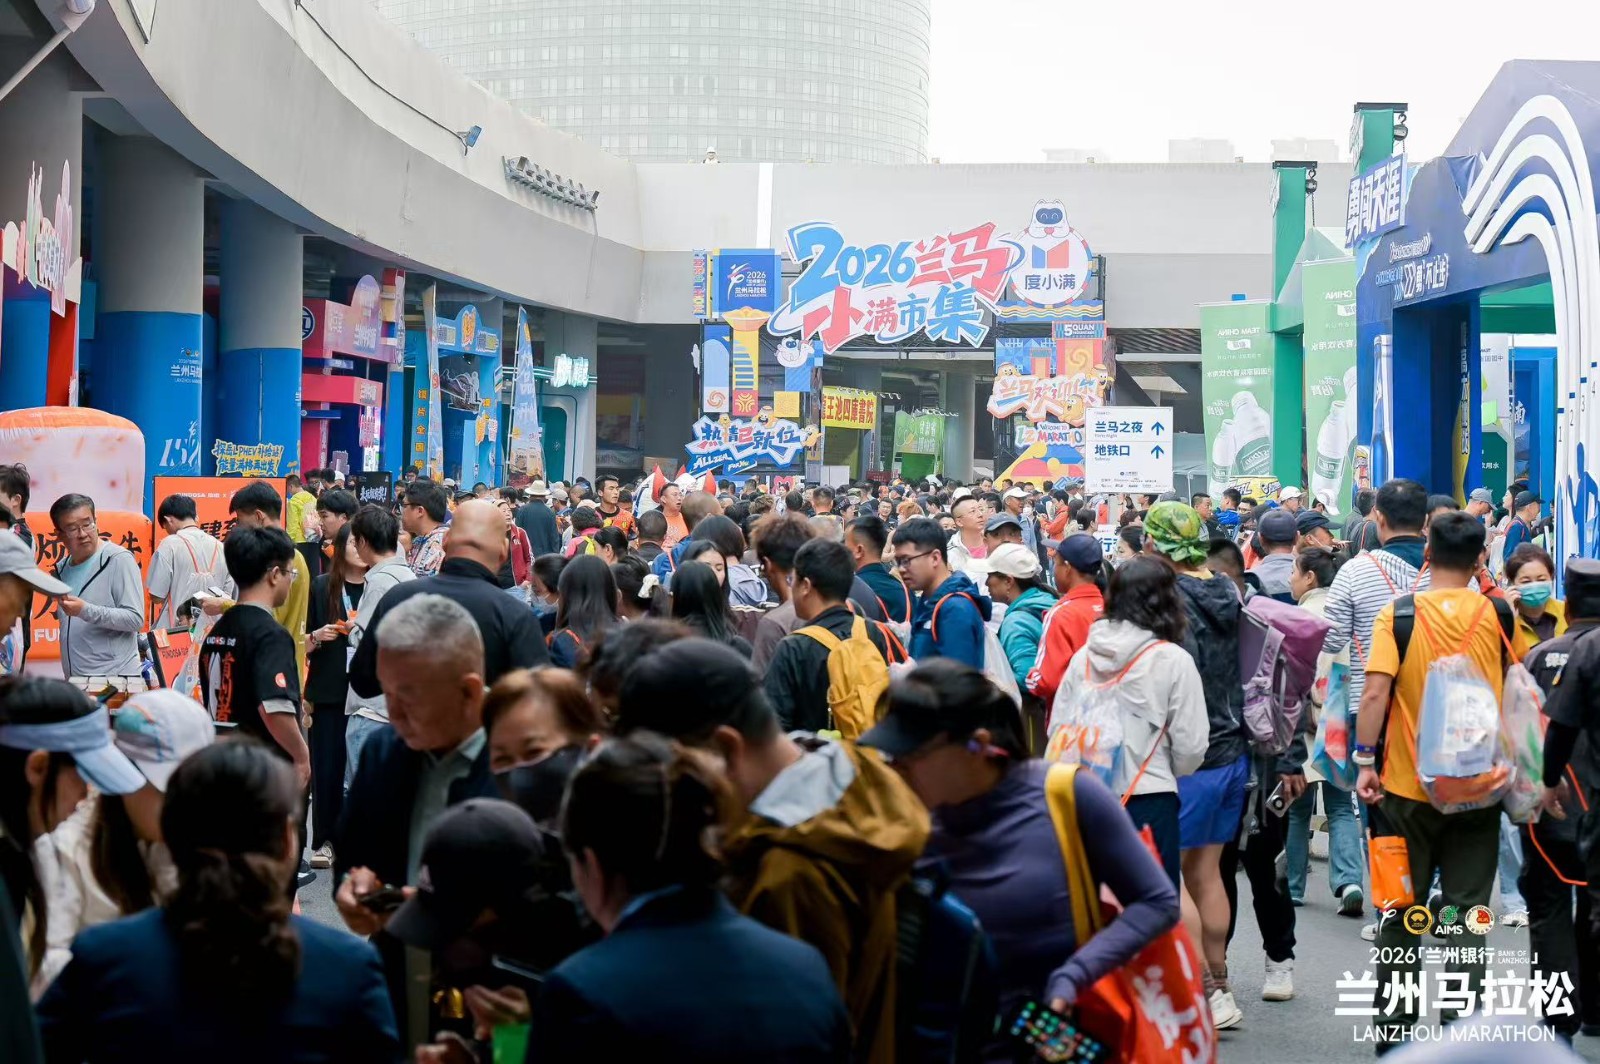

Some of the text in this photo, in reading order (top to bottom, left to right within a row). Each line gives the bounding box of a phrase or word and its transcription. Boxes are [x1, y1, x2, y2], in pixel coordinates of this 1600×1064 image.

[746, 271, 766, 279] 2026
[1024, 276, 1076, 291] 度小满
[803, 283, 988, 353] 小满市集
[1064, 324, 1072, 336] 5
[1095, 421, 1143, 433] 兰马之夜
[1095, 445, 1130, 456] 地铁口
